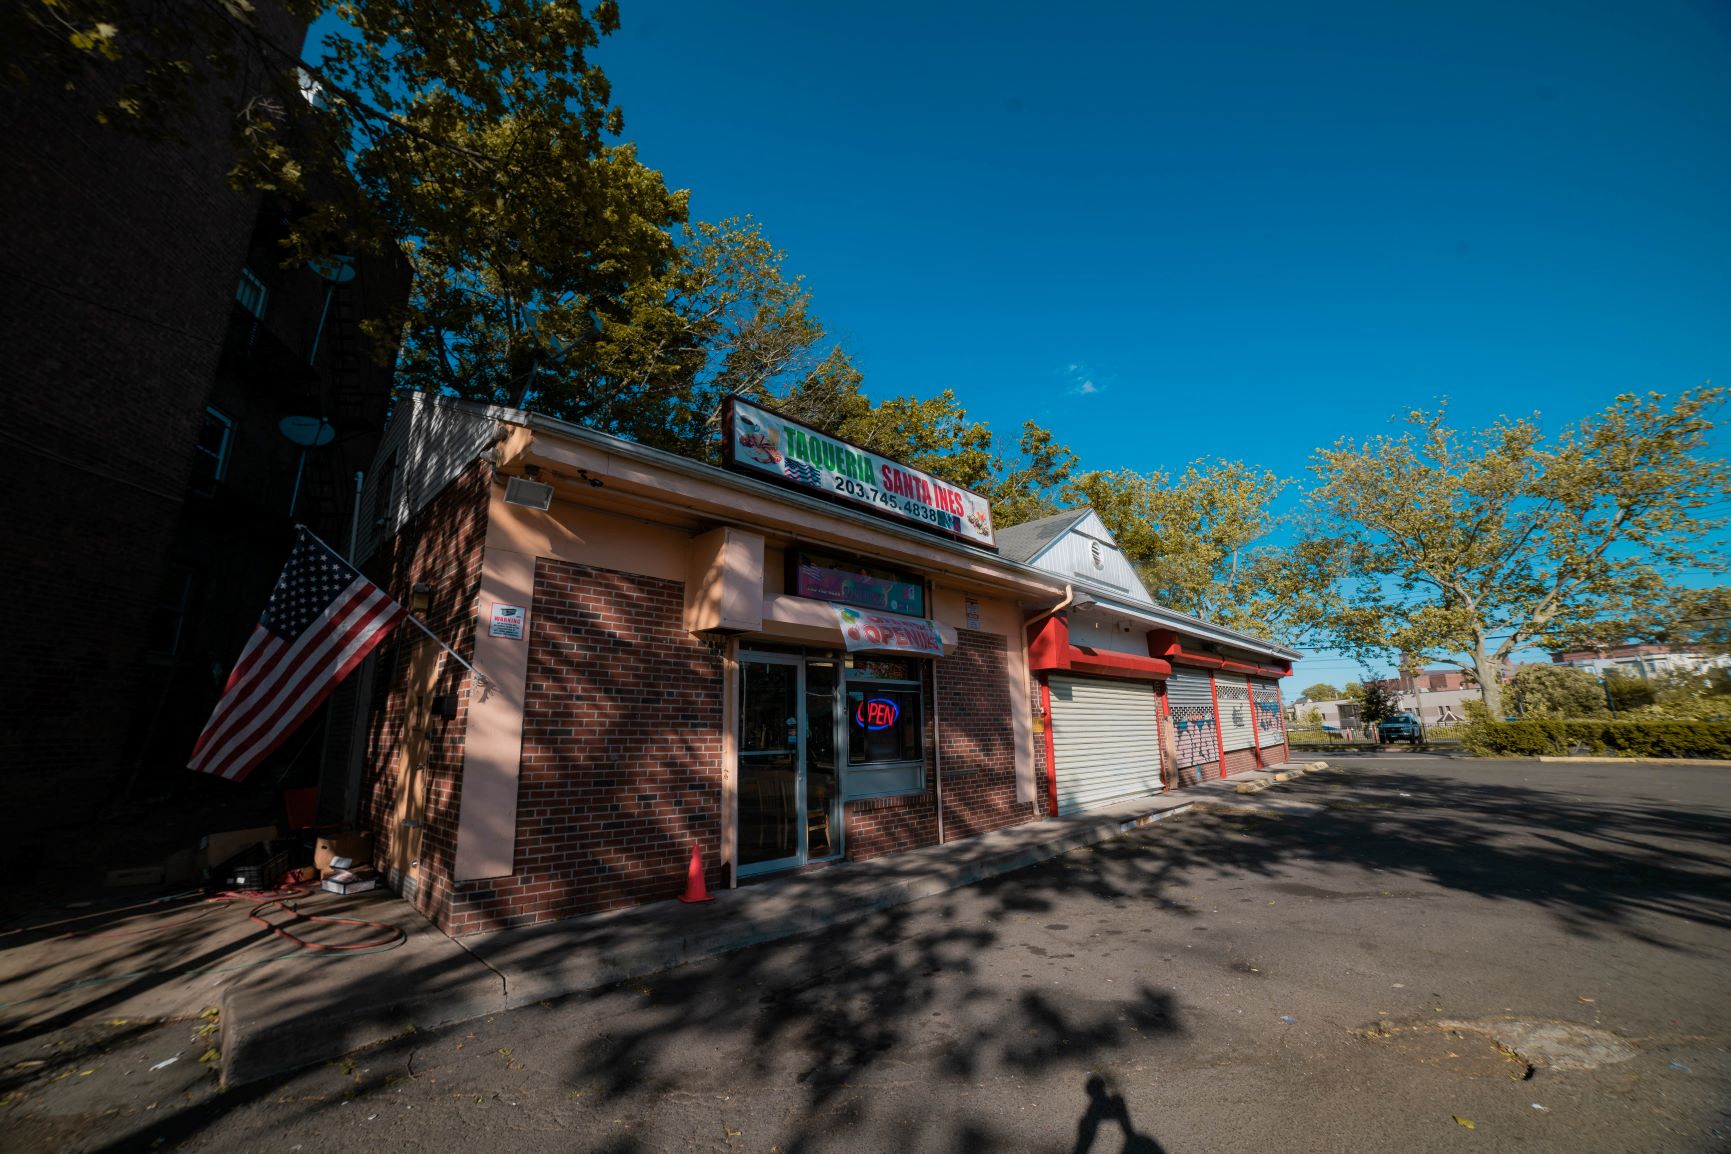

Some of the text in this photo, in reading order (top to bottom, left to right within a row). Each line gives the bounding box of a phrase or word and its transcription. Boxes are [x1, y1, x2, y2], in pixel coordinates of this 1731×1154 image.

[784, 427, 965, 517] TAQUERIA SANTA INES
[835, 477, 937, 522] 203.745.4838
[494, 616, 521, 624] WARNING
[857, 701, 895, 727] OPEN
